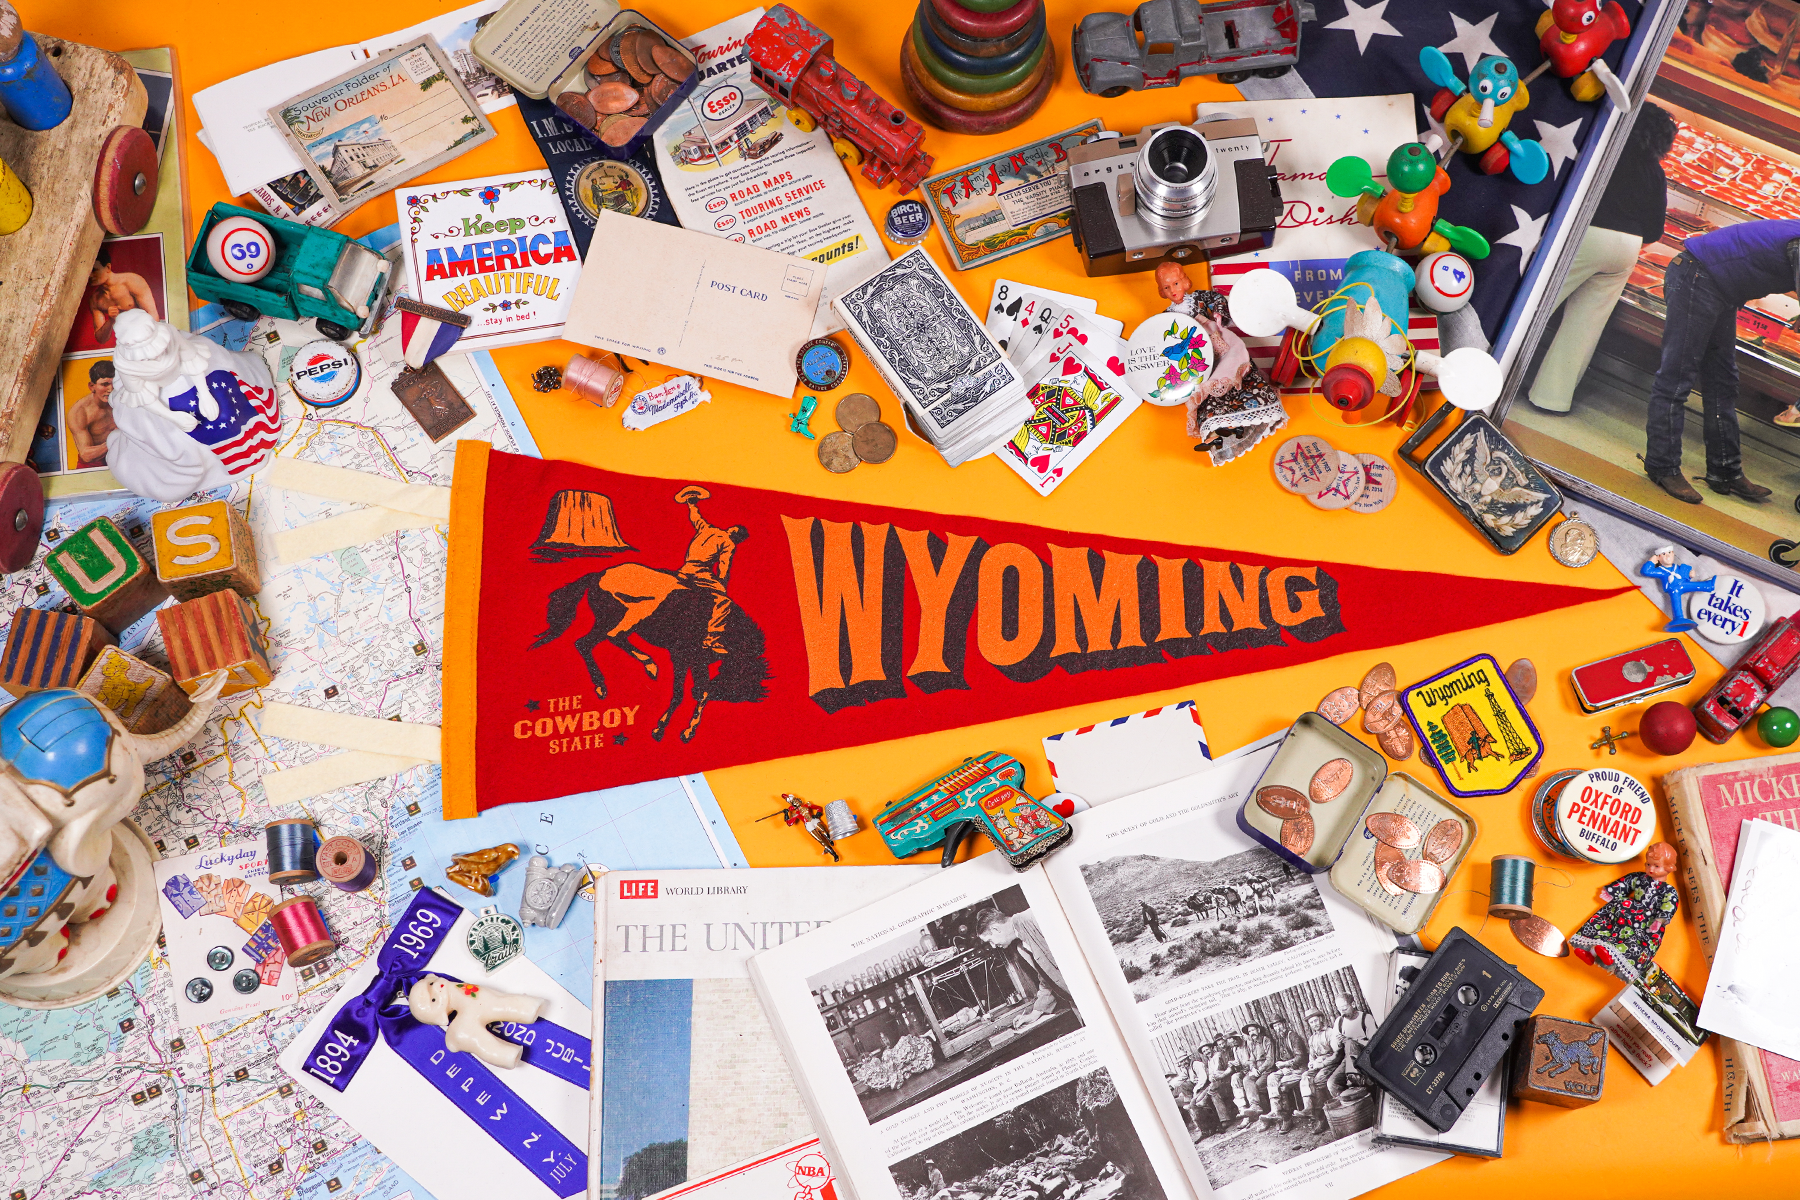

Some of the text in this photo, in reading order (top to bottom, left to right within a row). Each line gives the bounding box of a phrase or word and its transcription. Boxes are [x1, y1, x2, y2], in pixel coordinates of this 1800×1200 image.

[293, 63, 391, 116] Souvenir Folder of
[708, 91, 737, 114] Esso
[718, 103, 736, 116] DEALER
[304, 106, 331, 131] NEW
[548, 138, 592, 155] LOCAL
[1083, 144, 1251, 177] argus twenty
[942, 184, 963, 208] The
[958, 170, 987, 199] Army
[975, 181, 992, 196] and
[986, 162, 1013, 197] Navy
[1009, 147, 1049, 174] Needle
[1022, 185, 1039, 195] SERVE
[1040, 180, 1051, 188] YOU
[253, 187, 275, 208] ANDS,
[708, 199, 726, 210] Esso
[730, 184, 760, 202] ROAD
[763, 171, 793, 189] MAPS
[716, 217, 734, 229] Esso
[739, 196, 783, 220] TOURING
[785, 180, 826, 202] SERVICE
[890, 203, 922, 218] BIRCH
[1277, 200, 1361, 229] Dish
[460, 214, 526, 237] Keep
[748, 220, 778, 238] ROAD
[781, 206, 811, 224] NEWS
[893, 212, 924, 225] BEER
[230, 241, 261, 261] 69
[424, 230, 577, 281] AMERICA
[1294, 268, 1343, 283] FROM
[1452, 267, 1467, 283] 4
[442, 272, 561, 313] BEAUTIFUL
[710, 280, 738, 297] POST
[739, 287, 768, 302] CARD
[998, 285, 1009, 301] 8
[505, 315, 515, 325] in
[516, 311, 531, 323] bed
[1024, 300, 1036, 316] 4
[1040, 307, 1052, 324] Q
[1060, 314, 1075, 330] 5
[1056, 342, 1074, 355] J
[1127, 353, 1160, 365] IS THE
[1130, 345, 1156, 356] LOVE
[295, 357, 349, 380] PEPSI
[1039, 475, 1056, 488] J
[165, 515, 221, 565] S
[56, 528, 127, 594] U
[1727, 578, 1745, 599] It
[780, 514, 1346, 714] WYOMING
[1707, 591, 1752, 621] takes
[1416, 667, 1491, 708] Wyoming
[548, 695, 582, 712] THE
[513, 704, 641, 740] COWBOY
[548, 732, 604, 755] STATE
[1588, 770, 1651, 805] PROUD FRIEND
[1612, 784, 1624, 796] OF
[1716, 774, 1800, 809] MICKE
[1579, 784, 1643, 826] OXFORD
[1566, 801, 1642, 848] PENNANT
[1578, 827, 1618, 852] BUFFALO
[194, 848, 258, 871] Luckyday
[1667, 795, 1710, 945] MICKEY SEES THE
[622, 882, 748, 897] LIFE WORLD LIBRARY
[393, 907, 442, 960] 1969
[616, 923, 688, 953] THE
[850, 938, 865, 949] THE
[897, 906, 935, 928] GEOGRAPHIC
[1651, 1019, 1667, 1037] SPORT
[1666, 1034, 1682, 1052] COUPE
[309, 1028, 360, 1086] 1894
[144, 1077, 162, 1088] Albany
[1564, 1080, 1598, 1094] WOLF
[549, 1153, 578, 1185] JULY
[796, 1165, 827, 1178] NBA
